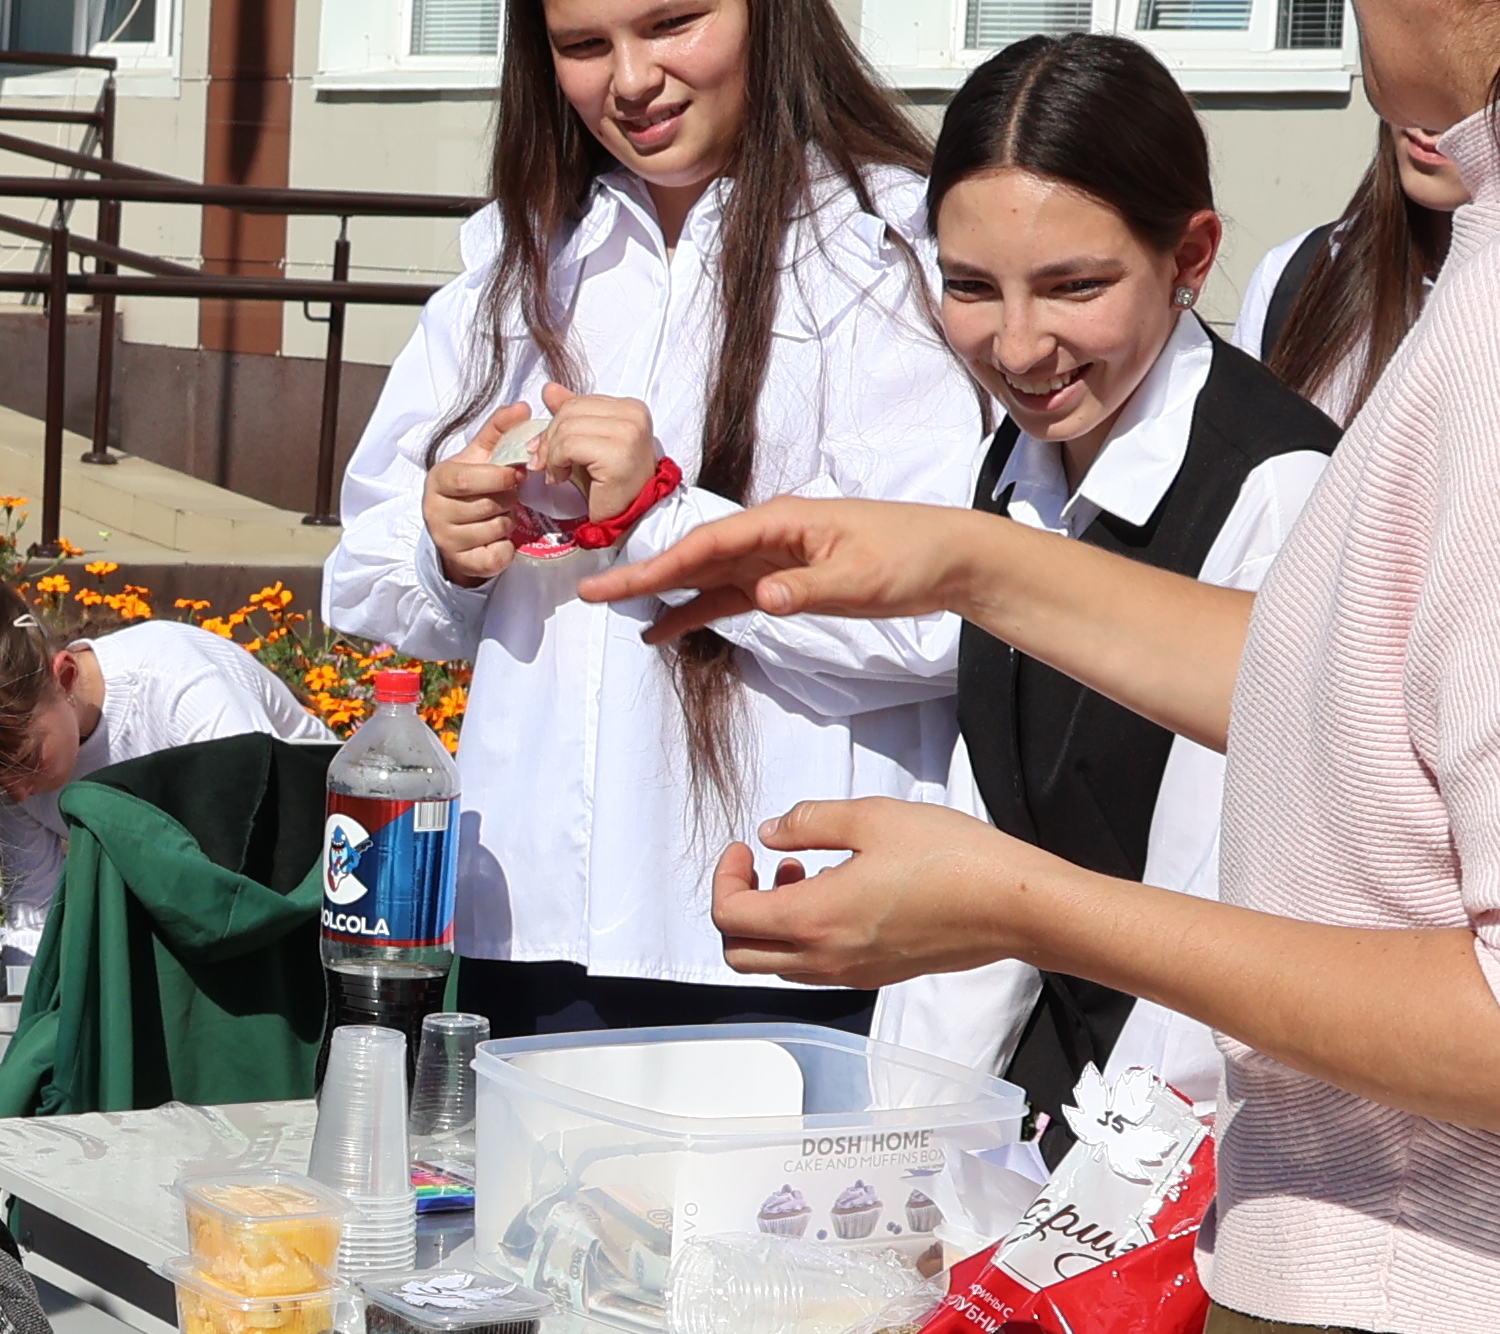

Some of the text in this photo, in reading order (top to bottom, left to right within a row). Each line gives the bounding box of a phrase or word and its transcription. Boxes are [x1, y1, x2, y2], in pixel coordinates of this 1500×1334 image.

[802, 1131, 930, 1157] DOSH HOME
[783, 1159, 823, 1173] CAKE
[825, 1156, 858, 1170] AND
[860, 1151, 918, 1169] MUFFINS
[920, 1148, 946, 1163] BOX
[969, 1283, 1004, 1313] ФИНЫ
